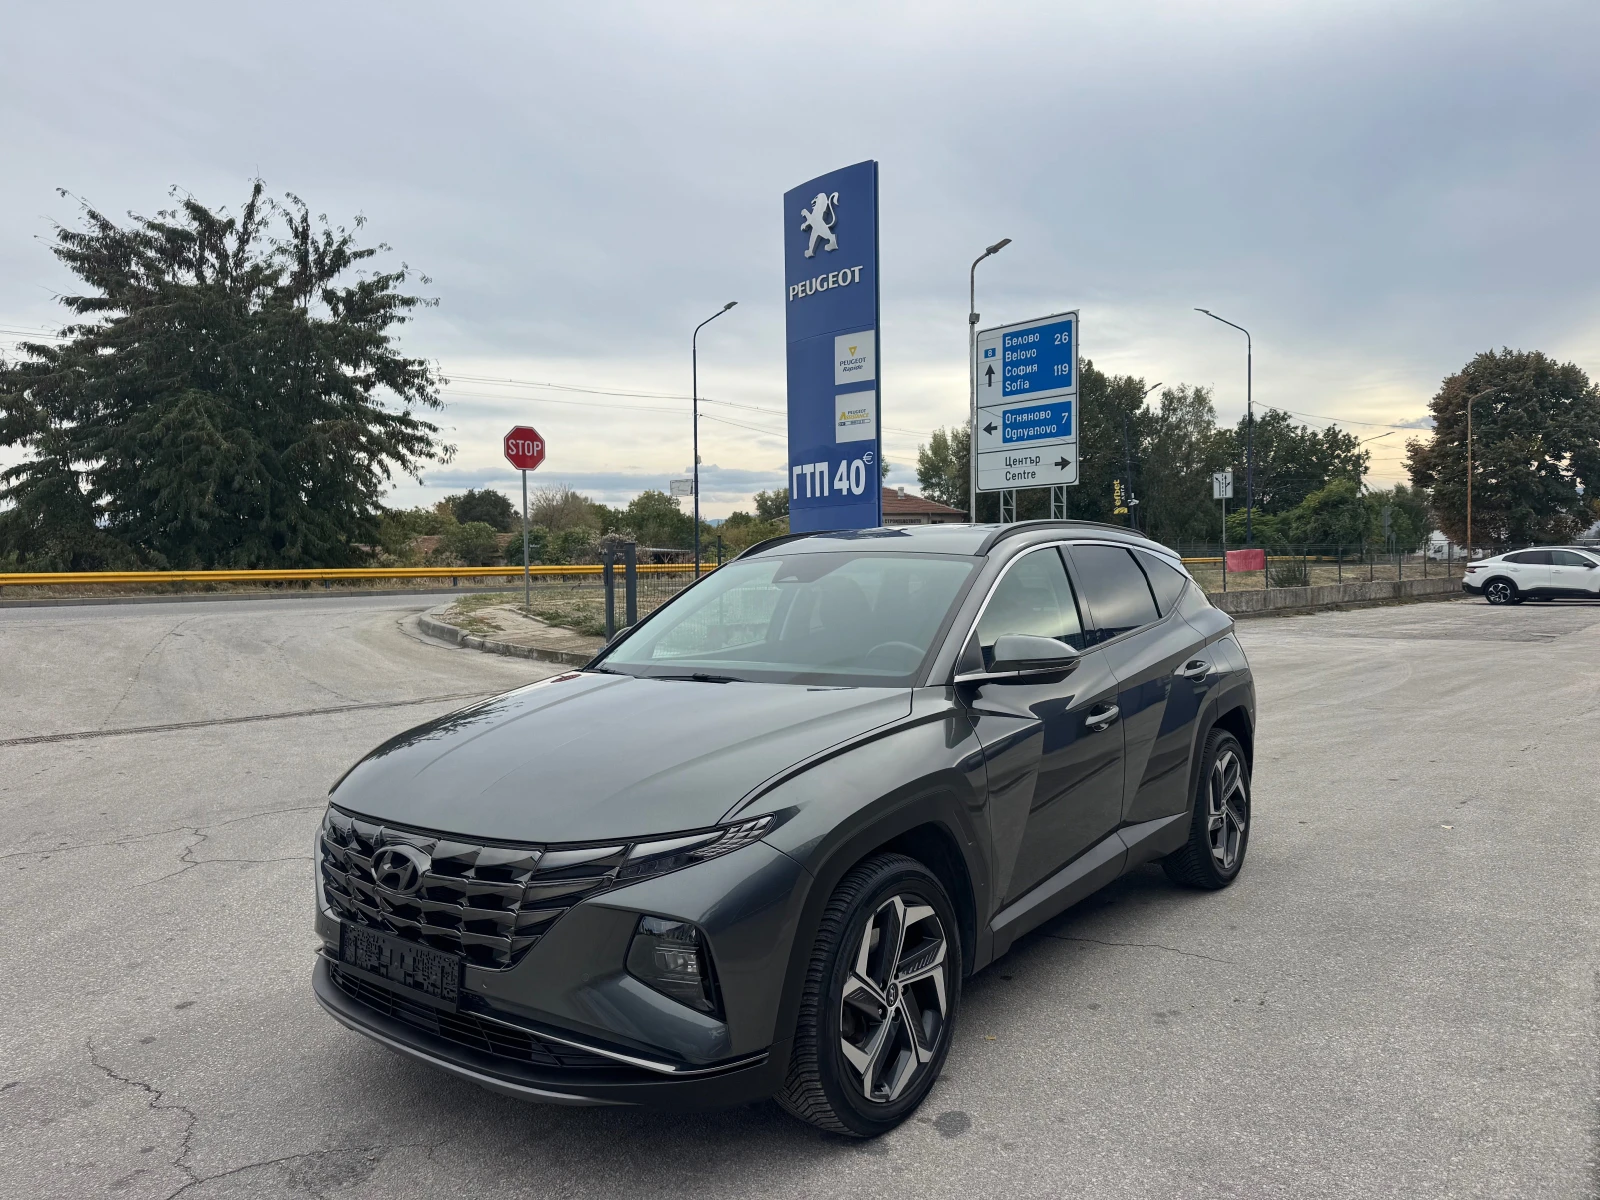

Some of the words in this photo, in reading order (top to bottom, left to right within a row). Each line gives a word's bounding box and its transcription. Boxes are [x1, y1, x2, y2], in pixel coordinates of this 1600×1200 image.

[789, 265, 863, 301] PEUGEOT
[1005, 332, 1040, 348] Белово
[1054, 331, 1069, 345] 26
[839, 356, 867, 366] PEUGEOT
[1005, 348, 1037, 362] Belovo
[842, 364, 863, 372] Rapide
[1005, 363, 1038, 377] София
[1053, 363, 1069, 376] 119
[1005, 379, 1030, 392] Sofia
[1005, 410, 1052, 424] Огняново
[1061, 412, 1069, 424] 7
[1005, 424, 1057, 441] Ognyanovo
[508, 439, 542, 457] STOP
[1005, 455, 1041, 468] Център
[792, 461, 829, 500] ГТП
[1005, 470, 1036, 482] Centre
[1113, 479, 1121, 506] efbet
